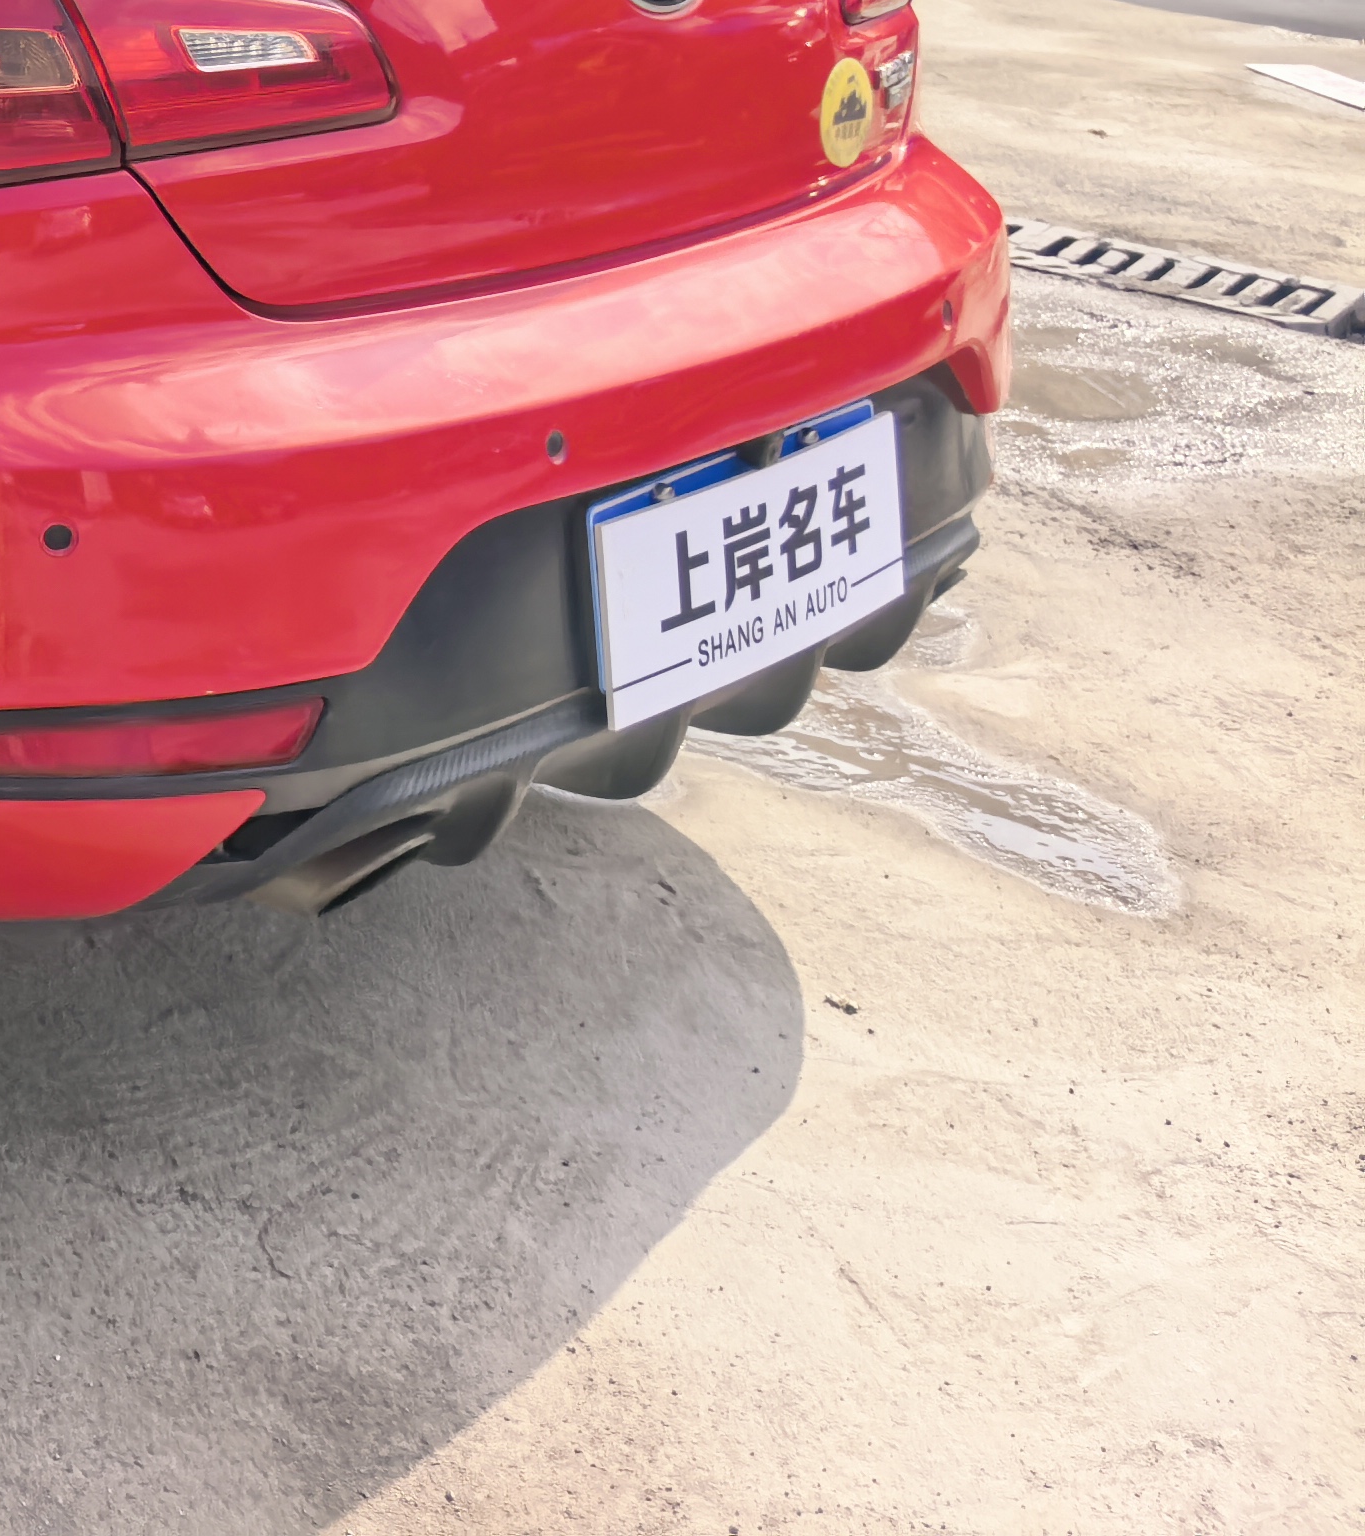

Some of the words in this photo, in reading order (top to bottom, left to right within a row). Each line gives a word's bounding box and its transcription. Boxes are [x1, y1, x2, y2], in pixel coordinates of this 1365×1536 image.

[661, 463, 871, 633] 上岸名车
[698, 616, 764, 667] SHANG
[773, 600, 797, 636] AN
[805, 576, 848, 620] AUTO
